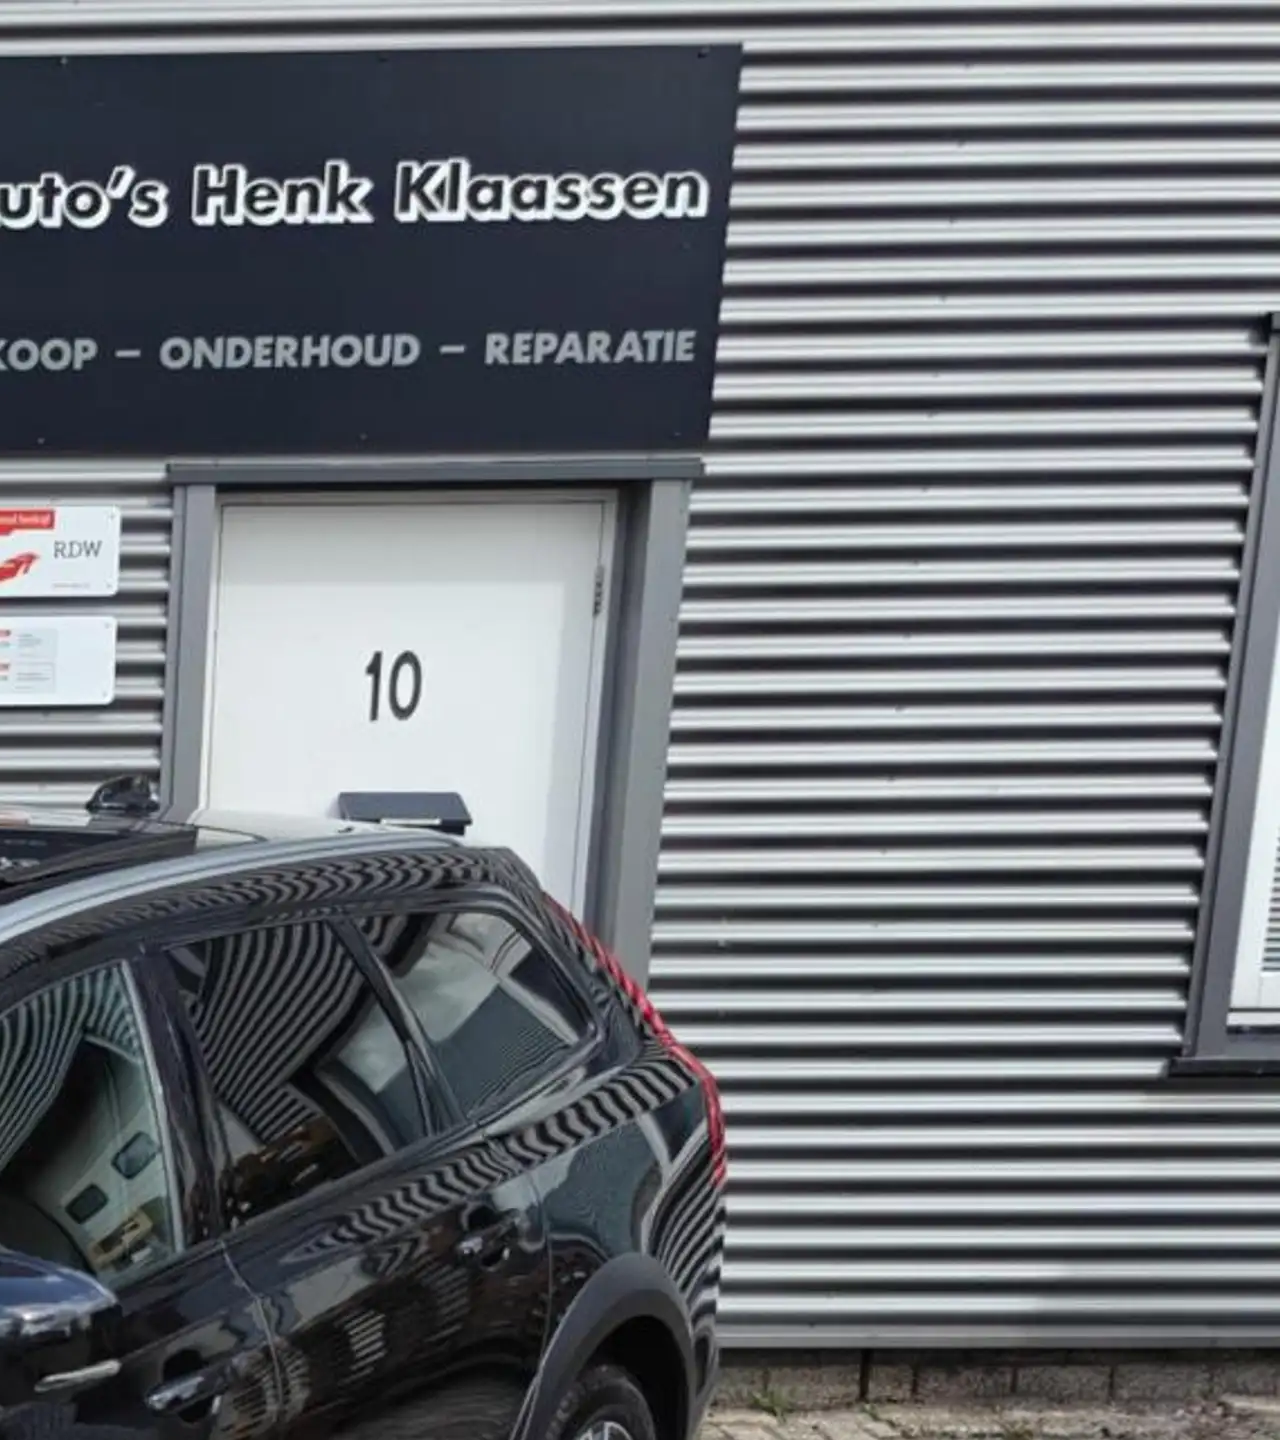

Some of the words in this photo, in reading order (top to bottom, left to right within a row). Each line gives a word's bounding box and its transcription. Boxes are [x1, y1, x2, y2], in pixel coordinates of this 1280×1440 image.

[192, 159, 374, 226] Henk
[394, 157, 709, 223] Klaassen
[159, 334, 421, 370] ONDERHOUD
[484, 330, 697, 365] REPARATIE
[53, 540, 103, 559] RDW
[365, 650, 422, 721] 10
